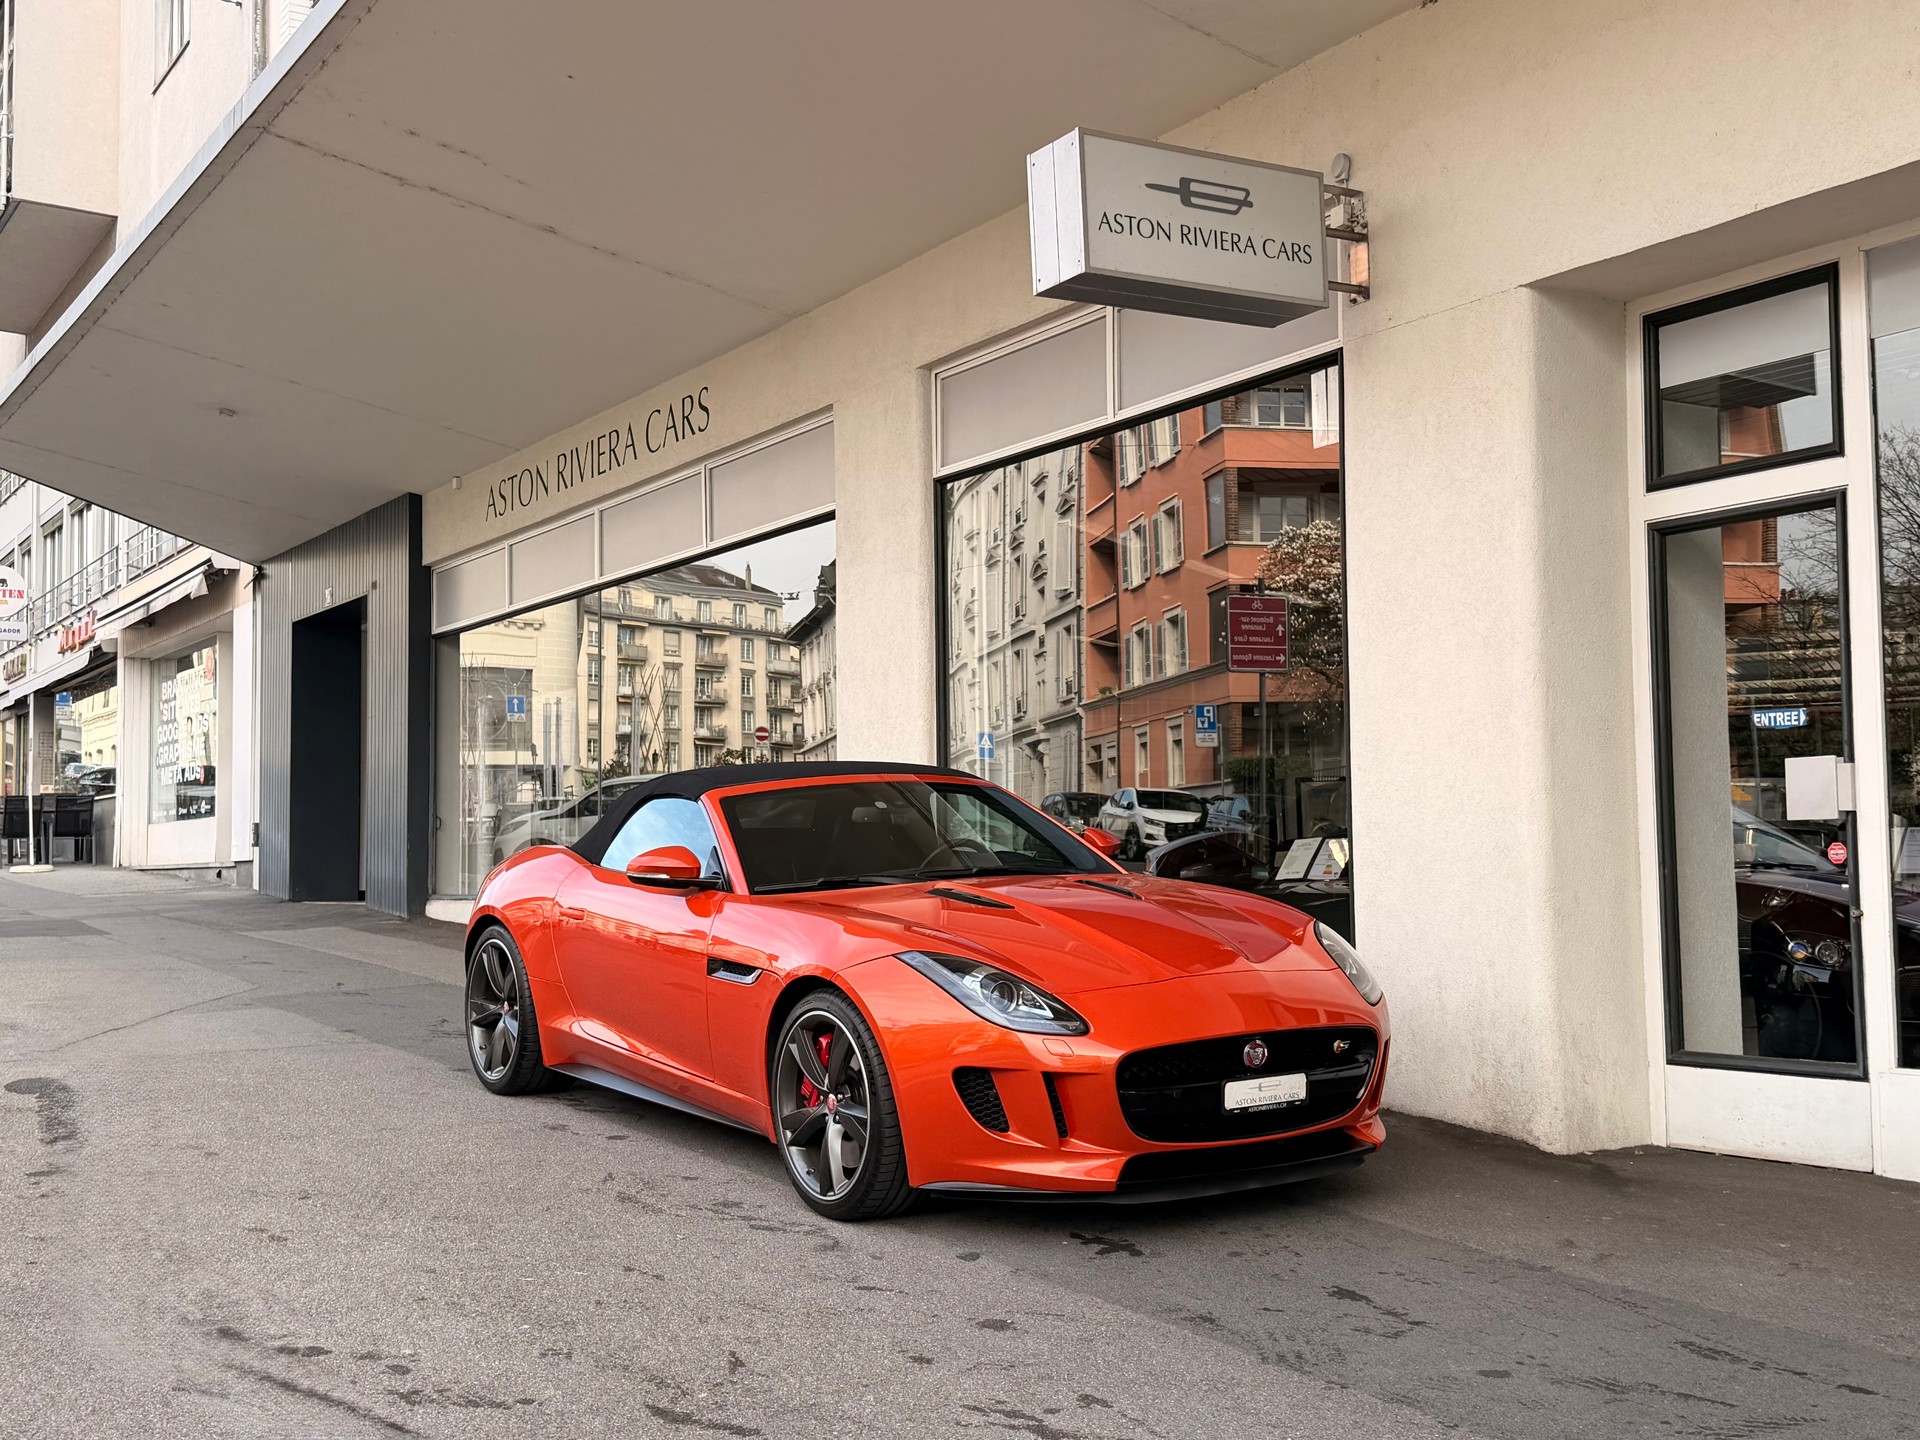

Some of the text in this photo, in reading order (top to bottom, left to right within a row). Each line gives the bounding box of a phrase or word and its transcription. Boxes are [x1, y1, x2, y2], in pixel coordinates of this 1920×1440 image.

[1098, 211, 1313, 265] ASTON RIVIERA CARS
[485, 386, 710, 522] ASTON RIVIERA CARS
[162, 672, 204, 701] BRANDING
[162, 699, 181, 721] SIT
[1754, 711, 1799, 727] ENTREE
[158, 736, 205, 765] GRAPHISME
[161, 762, 201, 786] META ADS
[1236, 1092, 1300, 1106] ASTON RIVIERA CARS
